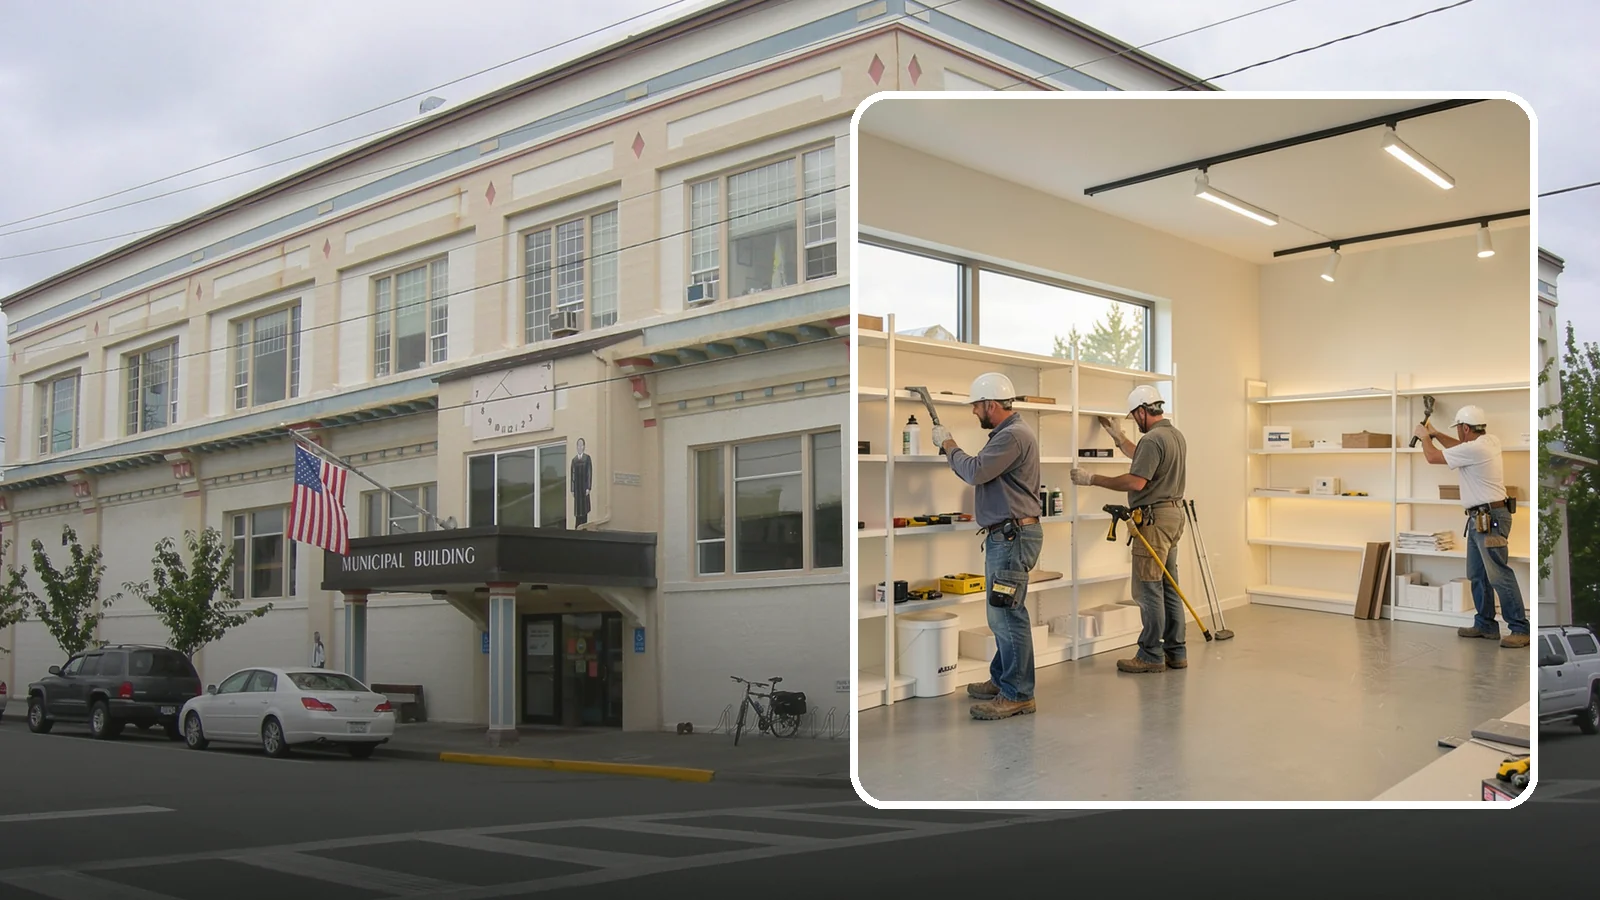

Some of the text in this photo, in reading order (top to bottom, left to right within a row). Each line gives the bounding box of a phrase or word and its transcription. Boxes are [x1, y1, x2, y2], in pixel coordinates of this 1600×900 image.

[536, 402, 540, 410] 4
[480, 407, 485, 415] 8
[488, 417, 492, 426] 9
[528, 414, 533, 422] 3
[495, 423, 500, 432] 10
[521, 420, 525, 428] 2
[501, 425, 506, 433] 11
[507, 425, 513, 433] 12
[342, 546, 475, 572] MUNICIPAL BUILDING
